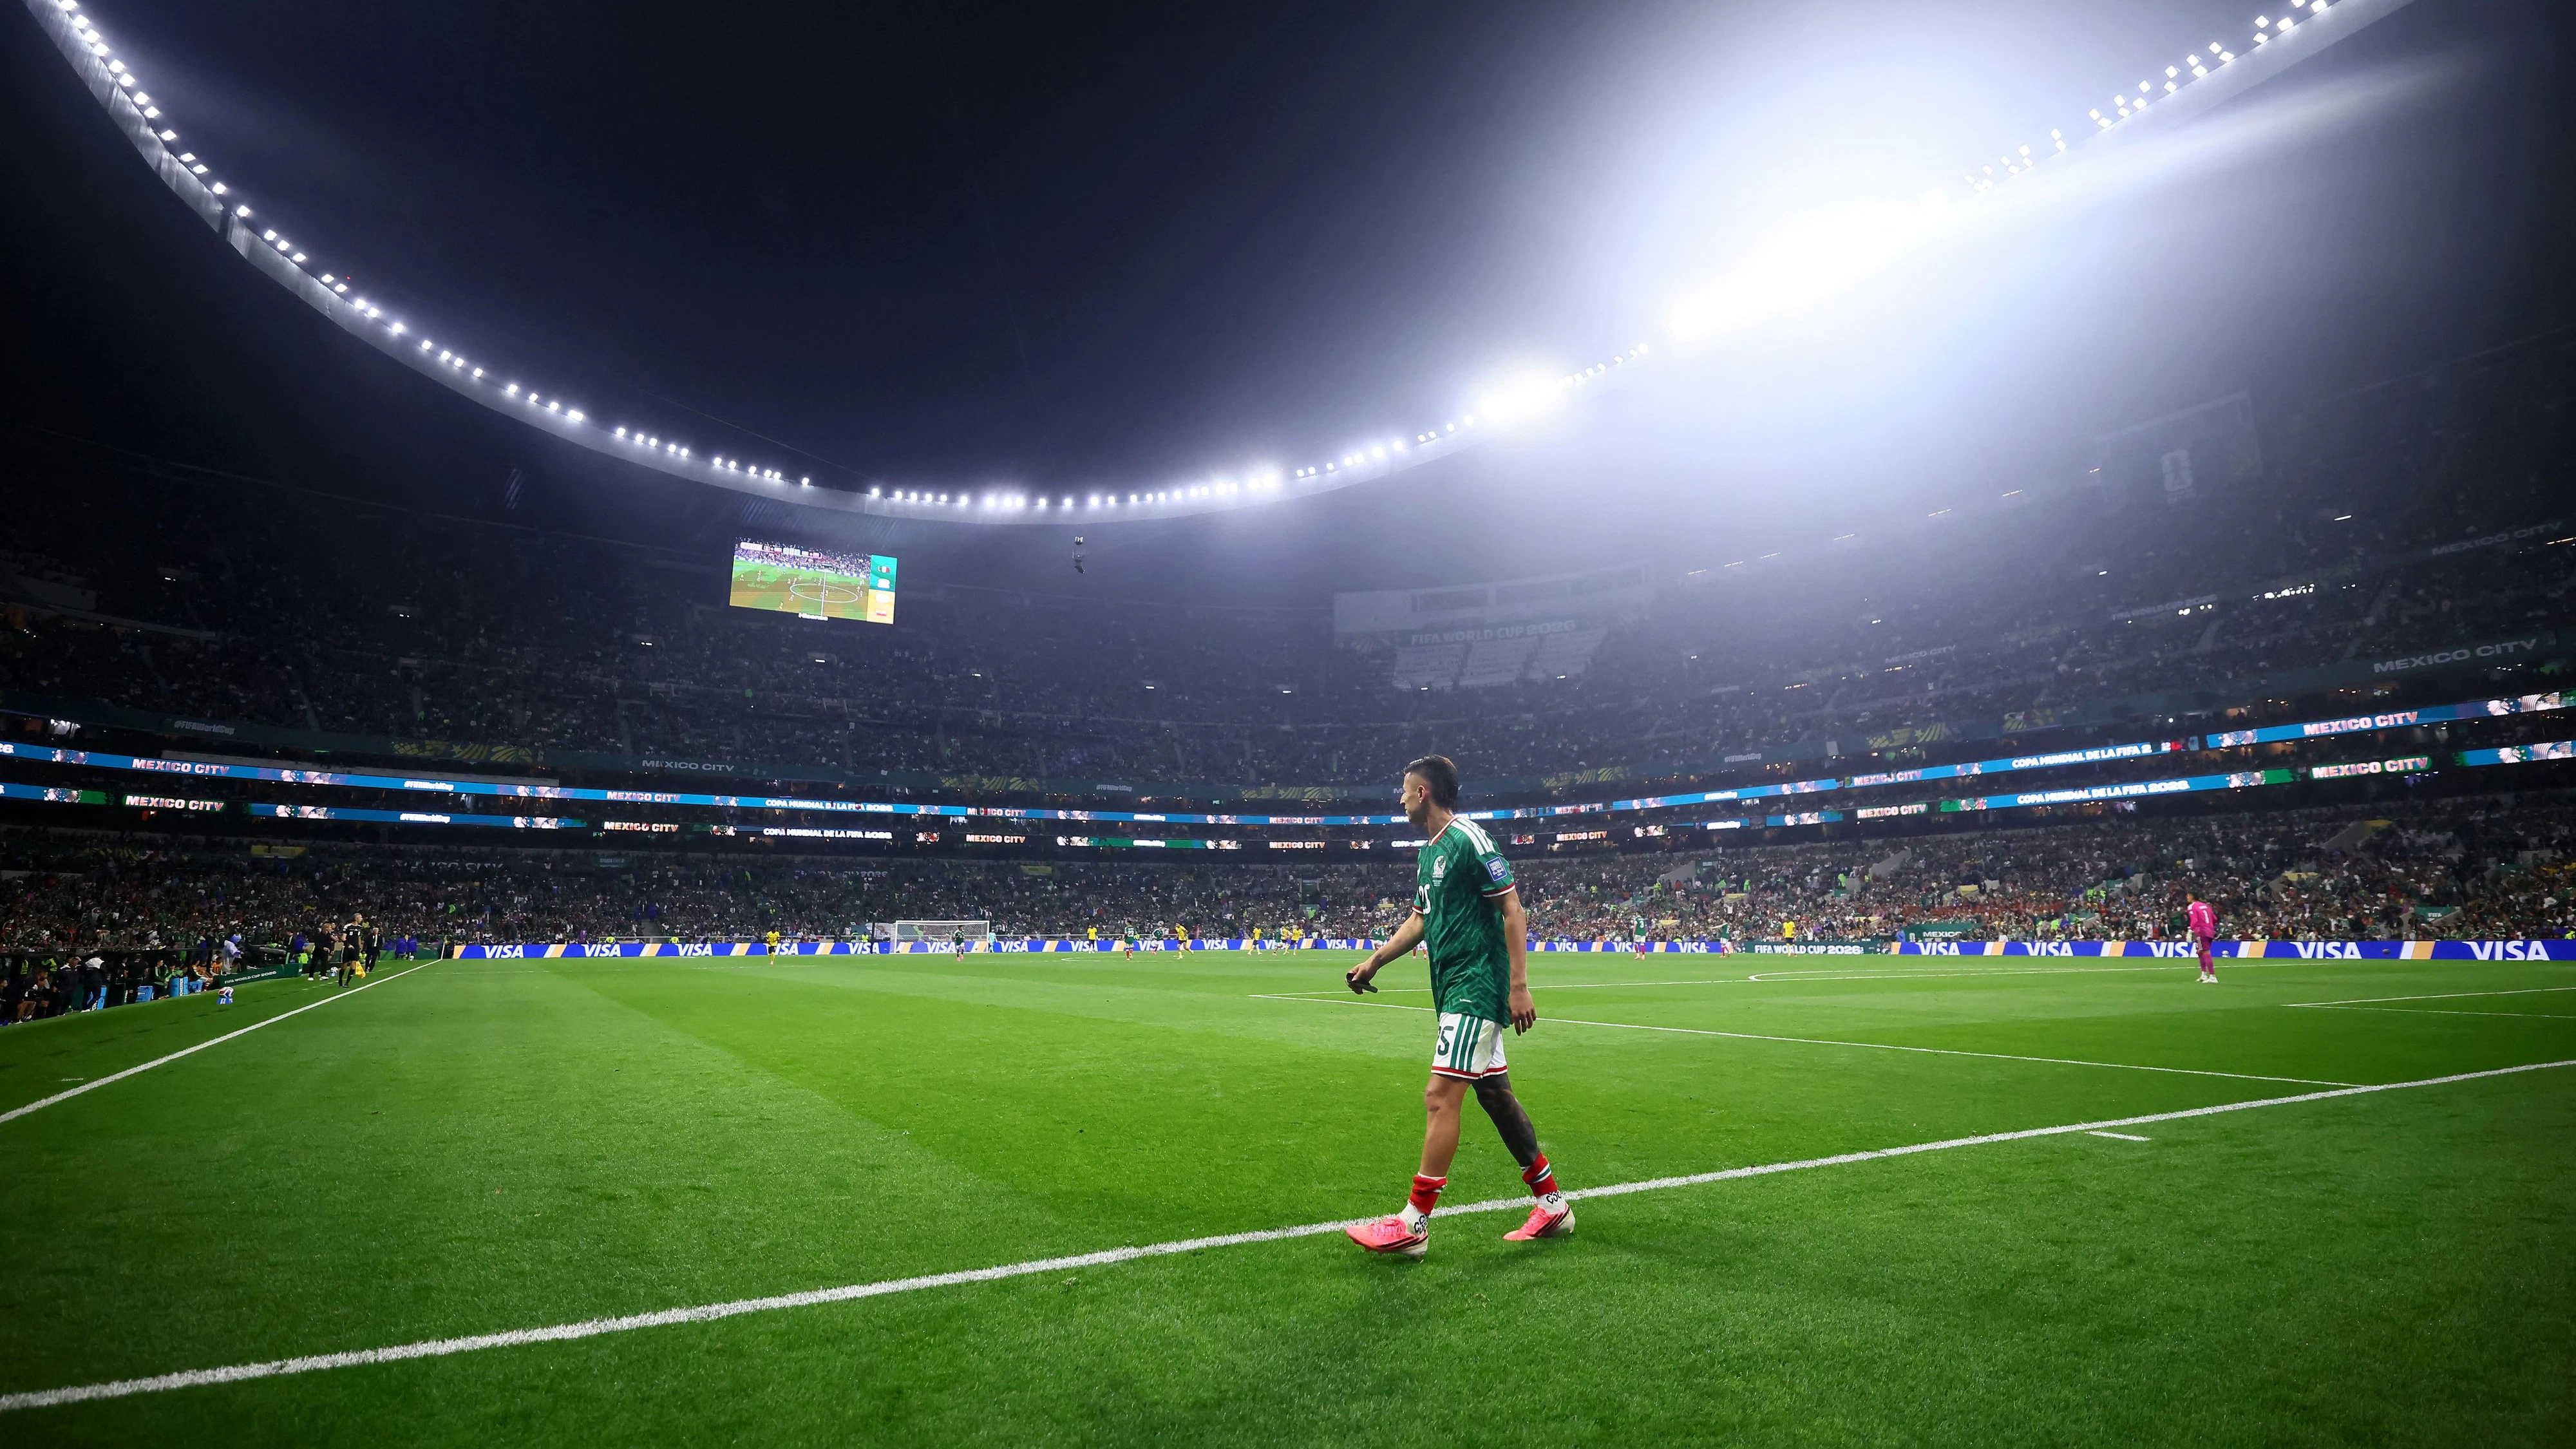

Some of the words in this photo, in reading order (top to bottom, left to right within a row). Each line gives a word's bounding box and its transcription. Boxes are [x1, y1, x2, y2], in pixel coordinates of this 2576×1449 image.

[2432, 533, 2509, 556] MEXICO
[2514, 520, 2562, 538] CITY
[1443, 629, 1493, 643] WORLD
[1496, 626, 1524, 639] CUP
[1526, 620, 1576, 636] 2026
[2373, 649, 2471, 673] MEXICO
[2476, 638, 2537, 657] CITY
[2303, 717, 2372, 735] MEXICO
[2374, 711, 2418, 727] CITY
[2011, 757, 2040, 768] COPA
[2040, 752, 2085, 766] MUNDIAL
[2085, 750, 2100, 761] DE
[2100, 748, 2116, 759] LA
[2116, 746, 2141, 757] FIFA
[132, 759, 191, 772] MEXICO
[194, 764, 230, 775] CITY
[702, 762, 735, 772] CITY
[2312, 761, 2382, 779] MEXICO
[2384, 757, 2428, 772] CITY
[1896, 771, 1922, 781] CITY
[607, 791, 652, 801] MEXICO
[654, 793, 681, 802] CITY
[2016, 793, 2045, 804] COPA
[2045, 789, 2092, 802] MUNDIAL
[2092, 786, 2107, 798] DE
[2107, 786, 2123, 797] LA
[2123, 783, 2147, 795] FIFA
[2147, 780, 2190, 793] 2026
[126, 795, 186, 809] MEXICO
[189, 800, 224, 811] CITY
[765, 799, 788, 808] COPA
[788, 800, 824, 809] MUNDIAL
[1857, 806, 1899, 819] MEXICO
[1900, 804, 1926, 815] CITY
[603, 821, 649, 831] MEXICO
[652, 823, 678, 833] CITY
[966, 834, 1003, 842] MEXICO
[1557, 832, 1587, 841] MEXICO
[1589, 830, 1607, 840] CITY
[2203, 910, 2210, 923] 1
[581, 944, 621, 957] VISA
[675, 943, 713, 956] VISA
[846, 942, 880, 954] VISA
[925, 942, 957, 953] VISA
[998, 941, 1028, 952] VISA
[1201, 940, 1228, 950] VISA
[1324, 939, 1347, 949] VISA
[1553, 942, 1578, 952] VISA
[1676, 942, 1707, 953] VISA
[1754, 945, 1772, 954] FIFA
[1807, 945, 1826, 954] CUP
[1827, 945, 1861, 954] 2026
[1915, 942, 1960, 955] VISA
[2022, 942, 2074, 956] VISA
[2289, 942, 2362, 959] VISA
[2461, 940, 2550, 960] VISA
[481, 945, 524, 958] VISA
[1438, 1026, 1454, 1056] 5
